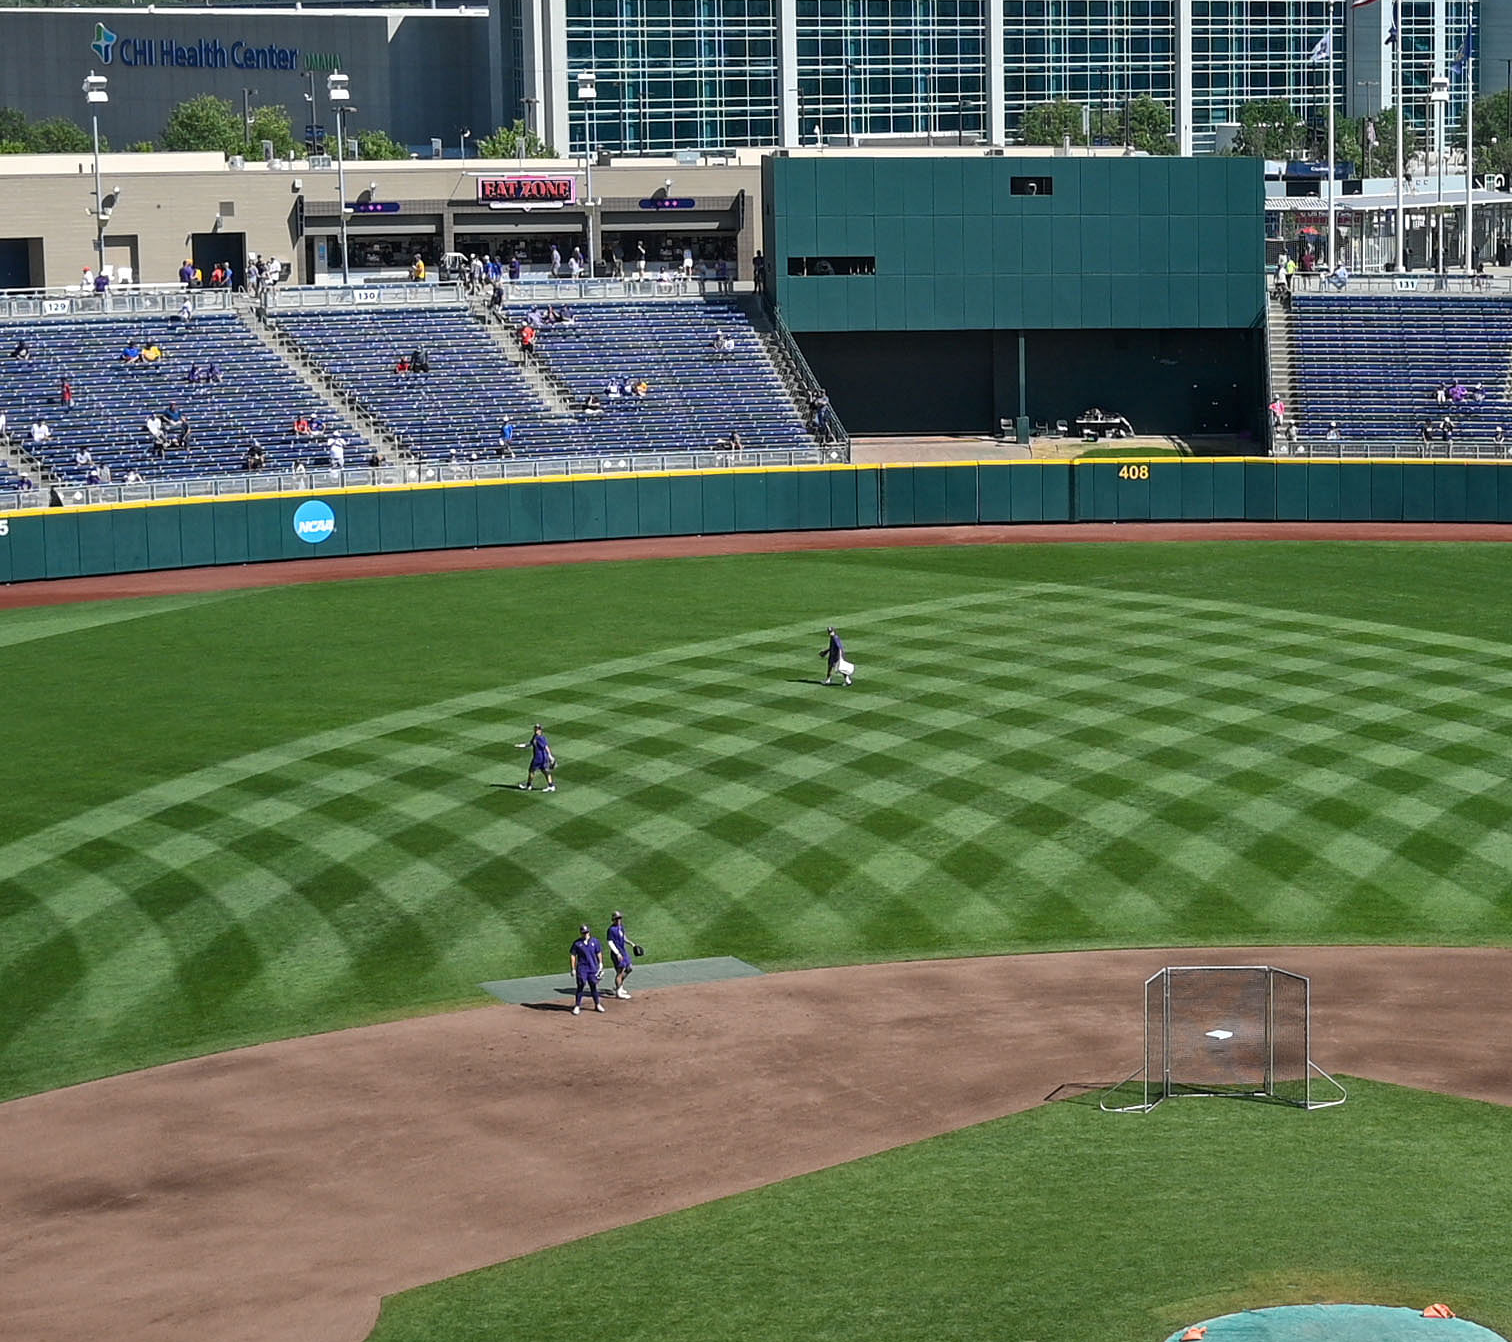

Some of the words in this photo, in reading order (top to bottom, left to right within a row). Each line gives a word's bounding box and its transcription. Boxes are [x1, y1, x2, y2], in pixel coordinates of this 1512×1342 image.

[119, 39, 155, 66] CHI
[160, 39, 228, 68] Health
[231, 41, 299, 70] Center
[483, 180, 518, 198] EAT
[520, 180, 570, 198] ZONE
[1399, 281, 1415, 289] 131
[358, 292, 375, 300] 130
[48, 302, 66, 311] 129
[1118, 465, 1149, 480] 408
[299, 519, 334, 533] NCAA
